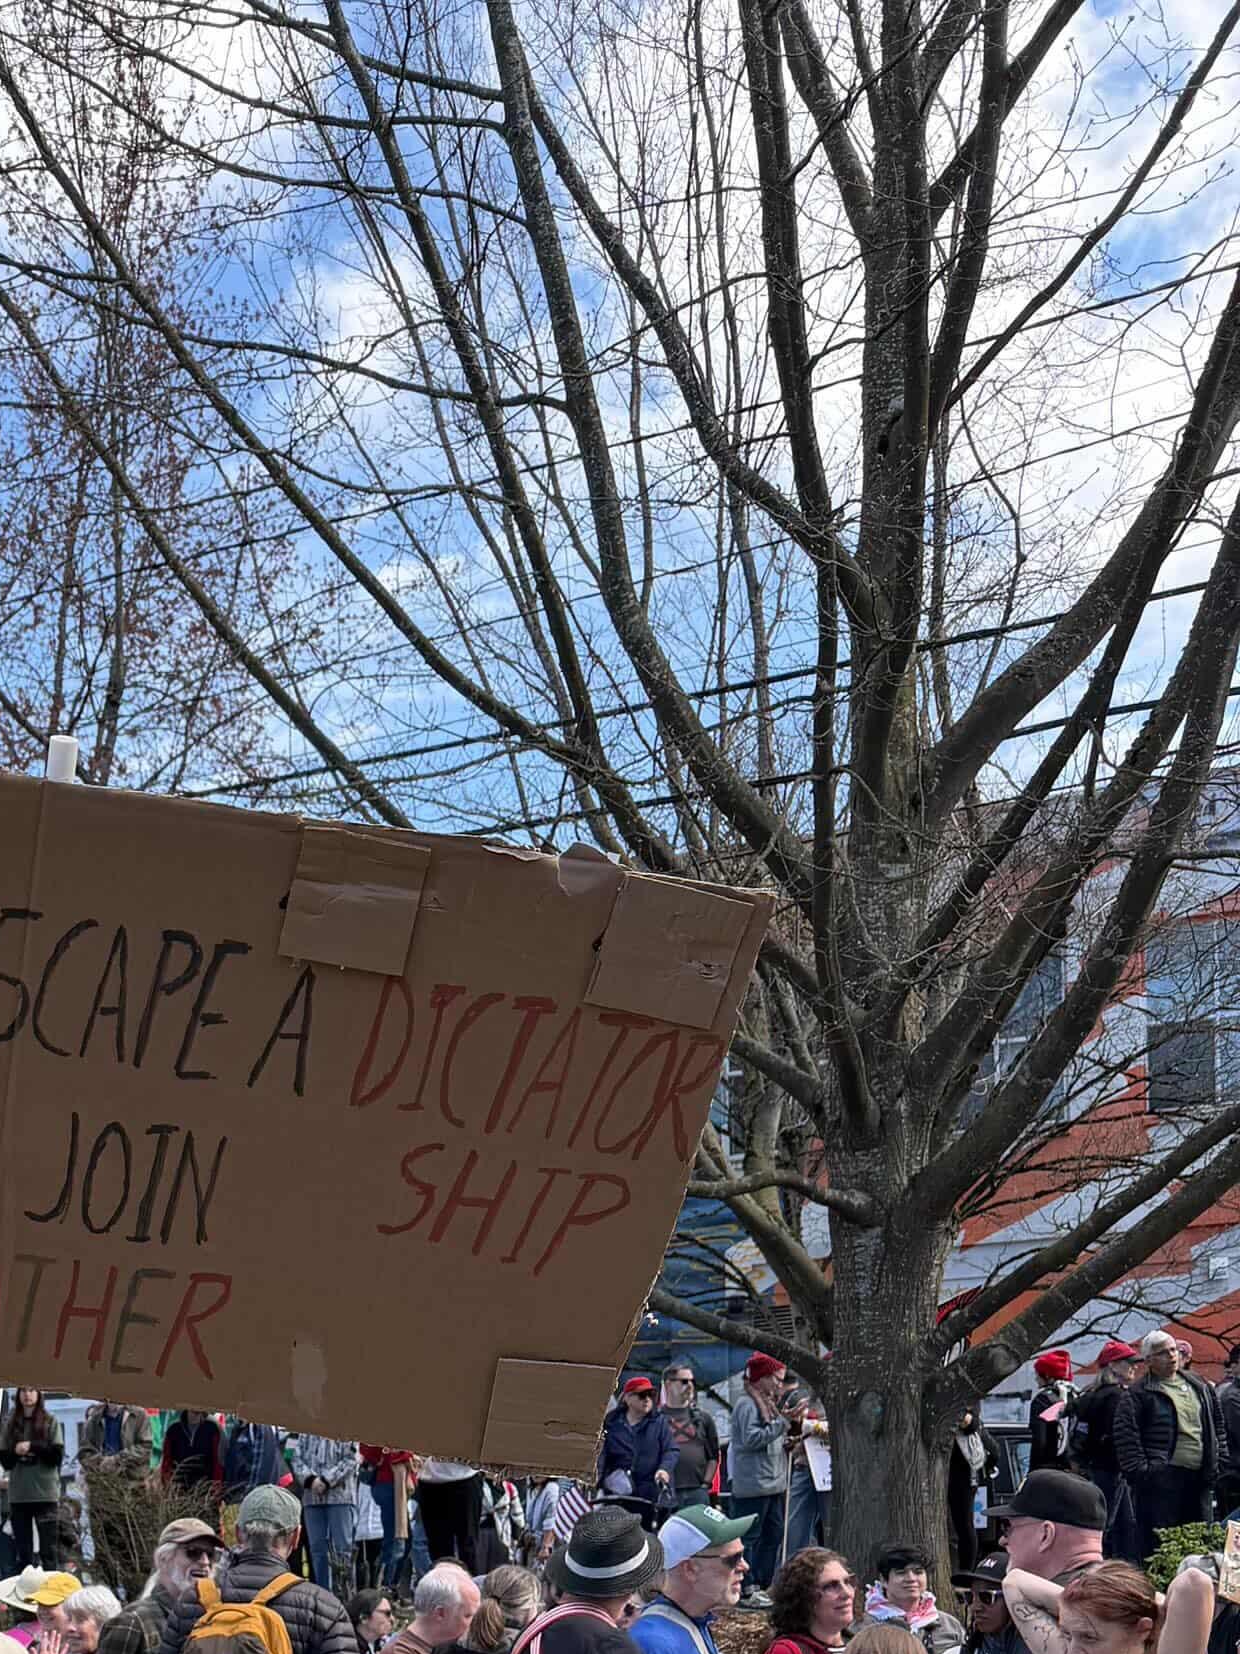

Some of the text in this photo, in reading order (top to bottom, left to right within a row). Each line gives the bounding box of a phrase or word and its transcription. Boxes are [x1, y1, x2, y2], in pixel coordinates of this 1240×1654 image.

[247, 965, 318, 1097] A
[348, 974, 726, 1162] DICTATOR
[24, 1111, 229, 1245] JOIN
[376, 1142, 631, 1277] SHIP
